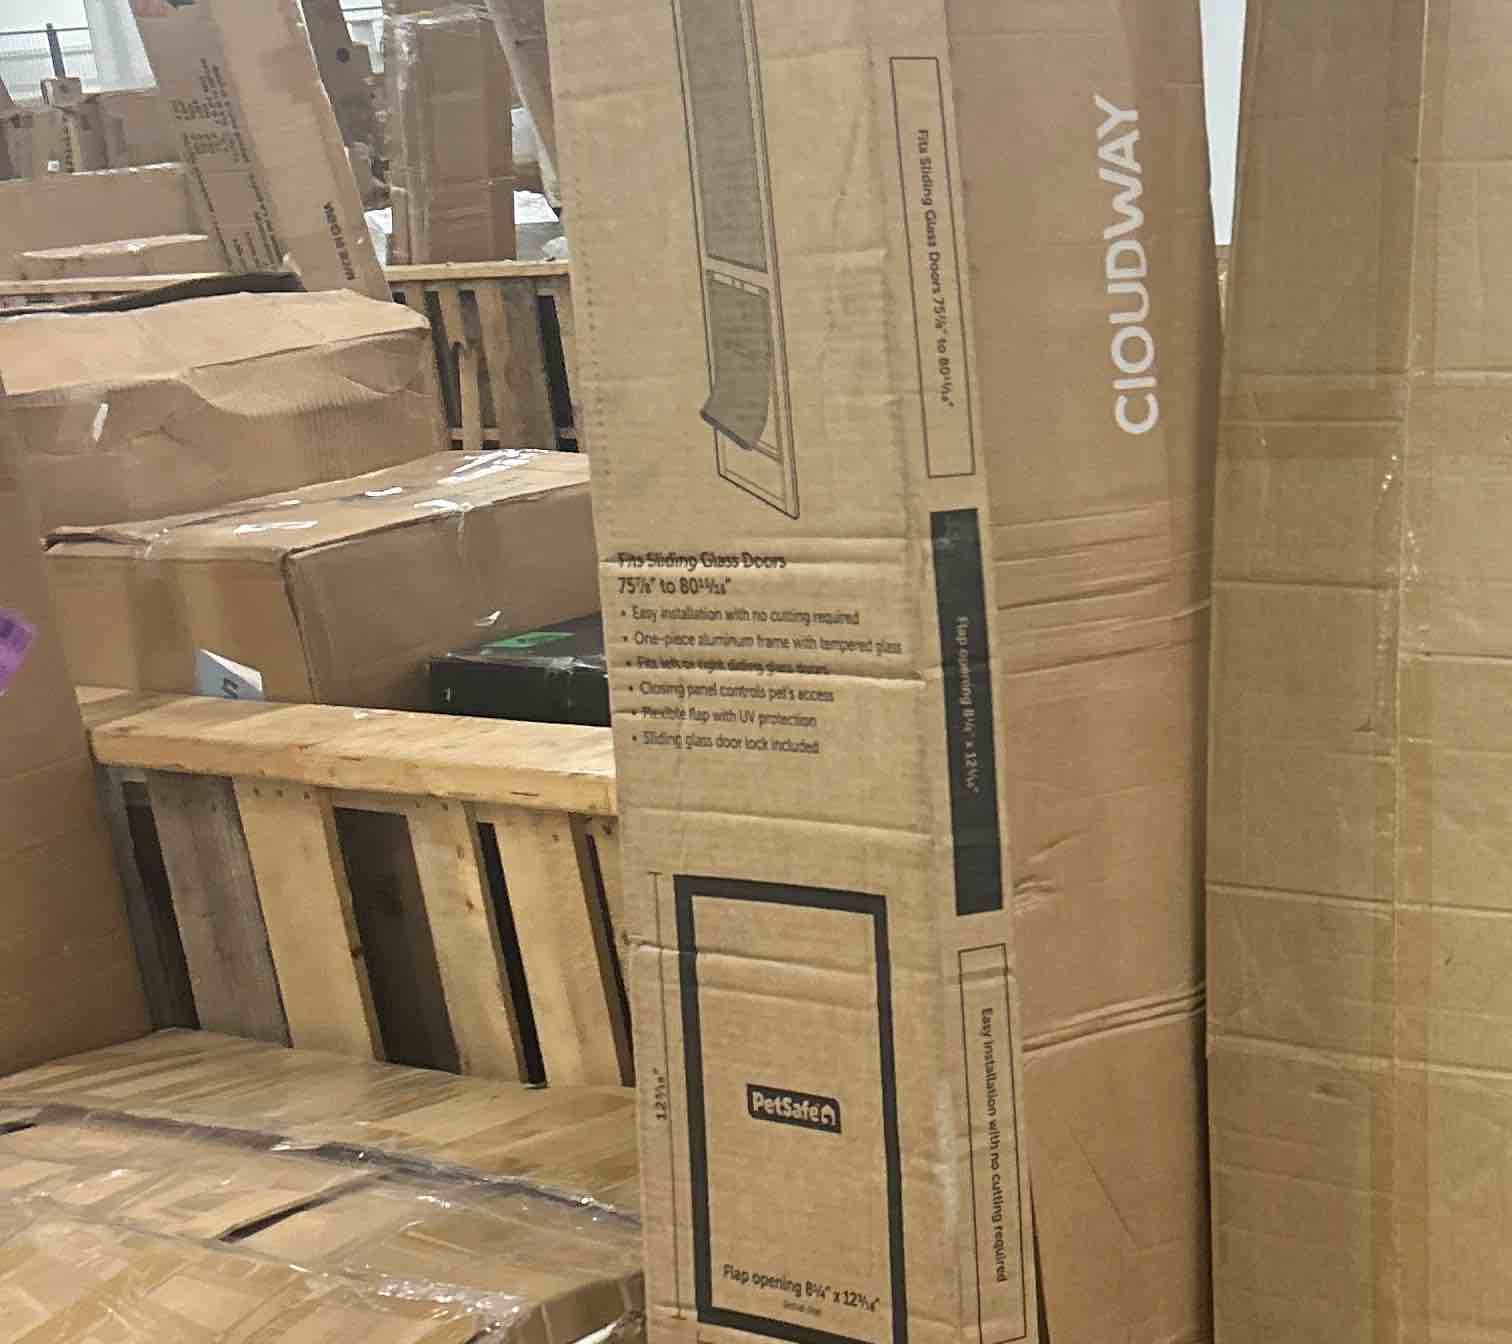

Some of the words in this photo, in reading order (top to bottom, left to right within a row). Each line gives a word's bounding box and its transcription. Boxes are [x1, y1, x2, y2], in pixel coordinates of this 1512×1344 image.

[920, 157, 936, 206] Sliding
[925, 209, 939, 248] Glass
[928, 251, 943, 295] Doors
[936, 337, 948, 355] to
[616, 551, 645, 568] Fits
[647, 551, 697, 572] Sliding
[700, 551, 739, 569] Glass
[741, 551, 787, 569] Doors
[660, 579, 676, 595] to
[632, 606, 658, 624] Easy
[661, 607, 722, 622] installation
[725, 607, 749, 623] with
[752, 611, 768, 623] no
[770, 609, 811, 627] cutting
[793, 635, 818, 650] with
[876, 639, 903, 656] glass
[639, 680, 686, 699] Closing
[687, 681, 718, 699] panel
[711, 708, 737, 723] with
[642, 730, 683, 750] Sliding
[685, 733, 713, 750] glass
[714, 733, 743, 750] door
[979, 1007, 995, 1038] Easy
[982, 1040, 999, 1116] installation
[750, 1089, 821, 1122] PetSafe
[988, 1119, 1003, 1150] with
[990, 1152, 1002, 1170] no
[990, 1173, 1007, 1222] cutting
[993, 1225, 1010, 1284] required
[722, 1263, 749, 1285] Flap
[751, 1273, 802, 1299] opening
